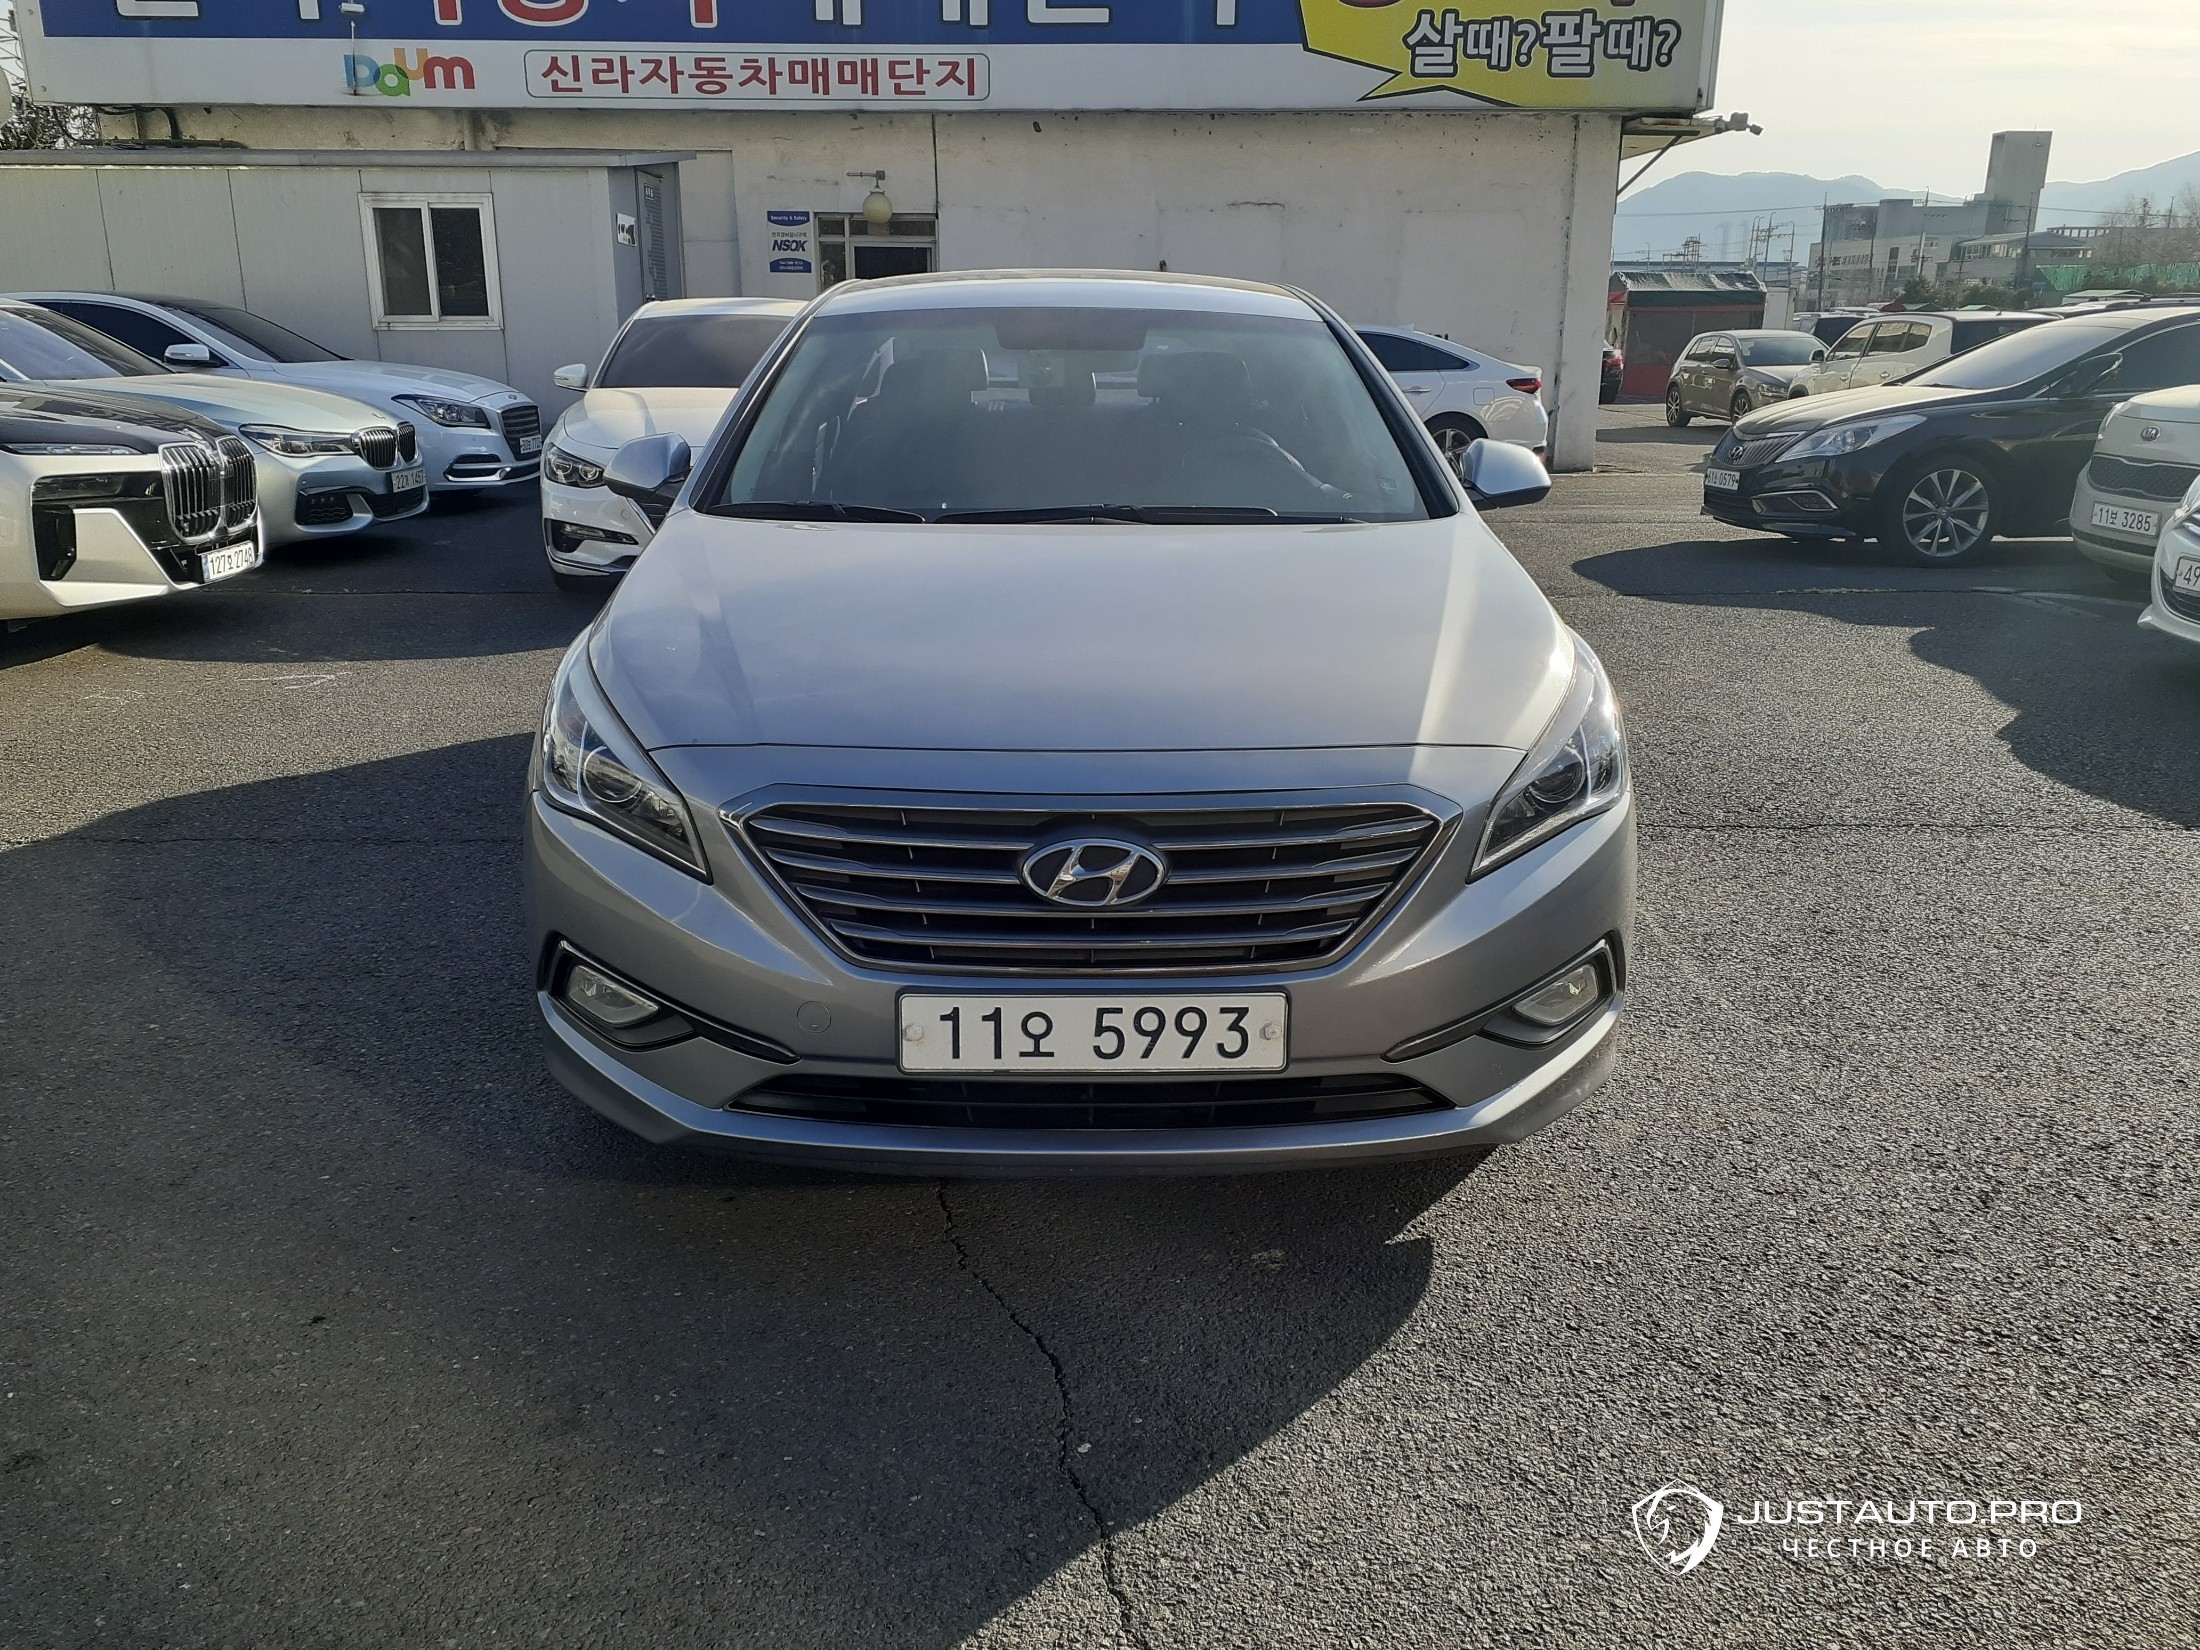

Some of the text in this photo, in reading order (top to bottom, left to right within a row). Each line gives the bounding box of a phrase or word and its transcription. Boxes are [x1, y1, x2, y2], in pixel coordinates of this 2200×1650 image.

[1404, 10, 1681, 77] 살때?팔때?
[540, 55, 976, 96] 신라자동차매매단지
[772, 239, 808, 252] NSOK
[1719, 472, 1736, 488] 0579
[2099, 507, 2152, 532] 11보 3285
[234, 547, 254, 569] 2748
[939, 1006, 1251, 1060] 11오 5993
